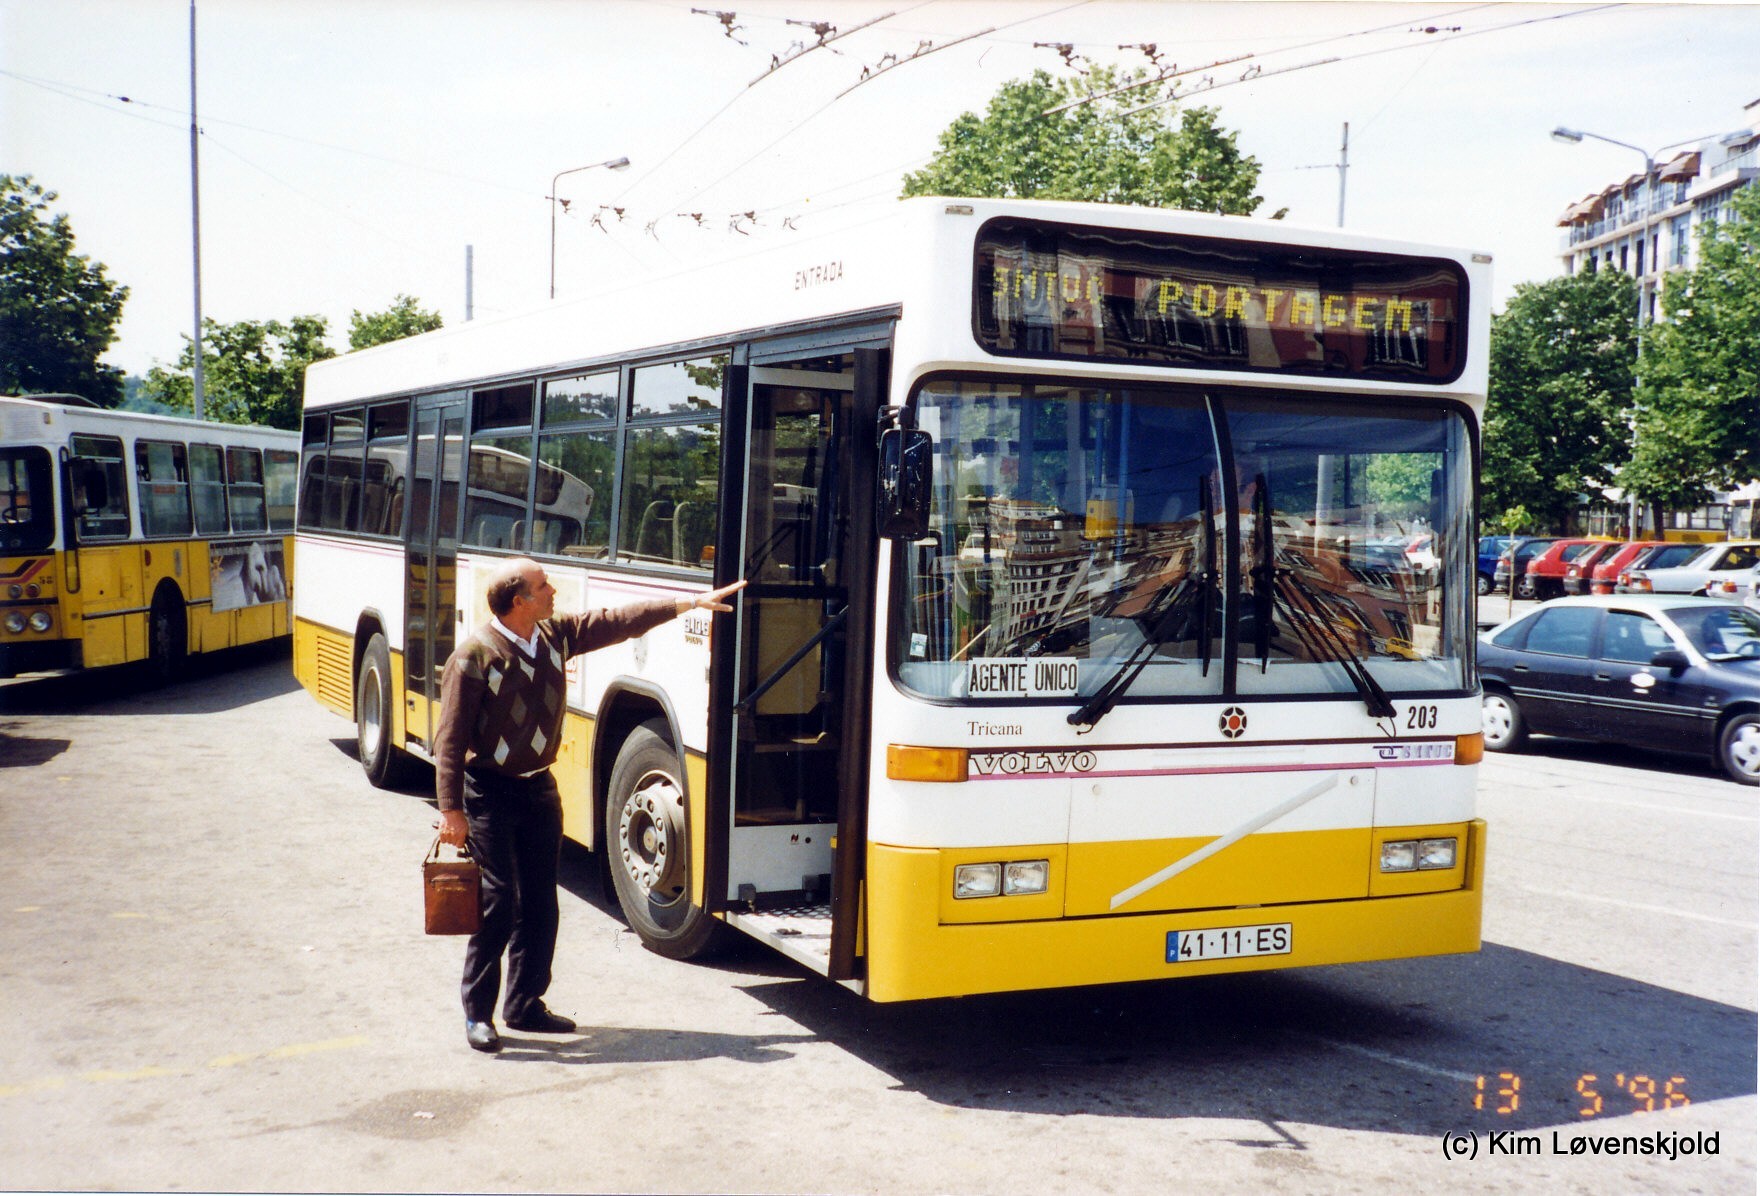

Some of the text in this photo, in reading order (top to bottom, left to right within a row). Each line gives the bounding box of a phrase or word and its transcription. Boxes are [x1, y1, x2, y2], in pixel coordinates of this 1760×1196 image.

[795, 260, 843, 290] ENTRADA
[1159, 280, 1412, 332] PORTAGEM
[970, 661, 1078, 692] AGENTE ÚNICO
[967, 721, 1023, 736] Tricana
[1407, 705, 1438, 729] 203
[970, 750, 1098, 776] VOLVO
